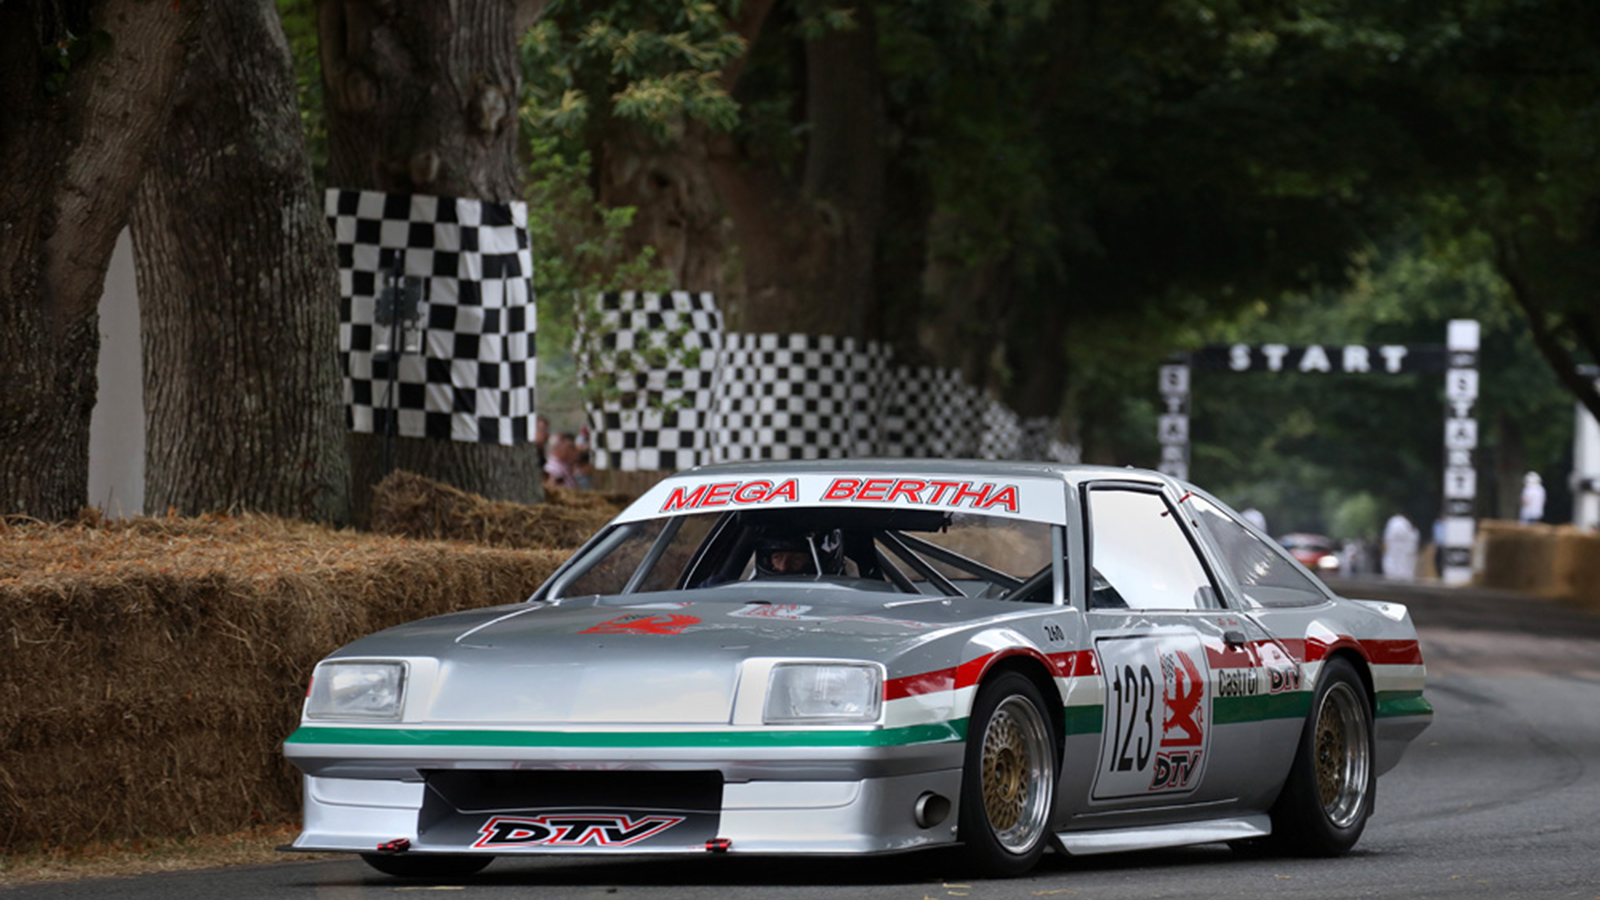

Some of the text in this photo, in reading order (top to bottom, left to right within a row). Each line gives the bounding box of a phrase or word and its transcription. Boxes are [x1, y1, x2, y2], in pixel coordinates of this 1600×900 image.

[1229, 343, 1408, 373] START
[660, 477, 1020, 513] MEGA BERTHA
[1043, 624, 1065, 641] 260
[1110, 664, 1154, 772] 123
[1149, 750, 1203, 791] DTV
[470, 815, 687, 849] DTV
